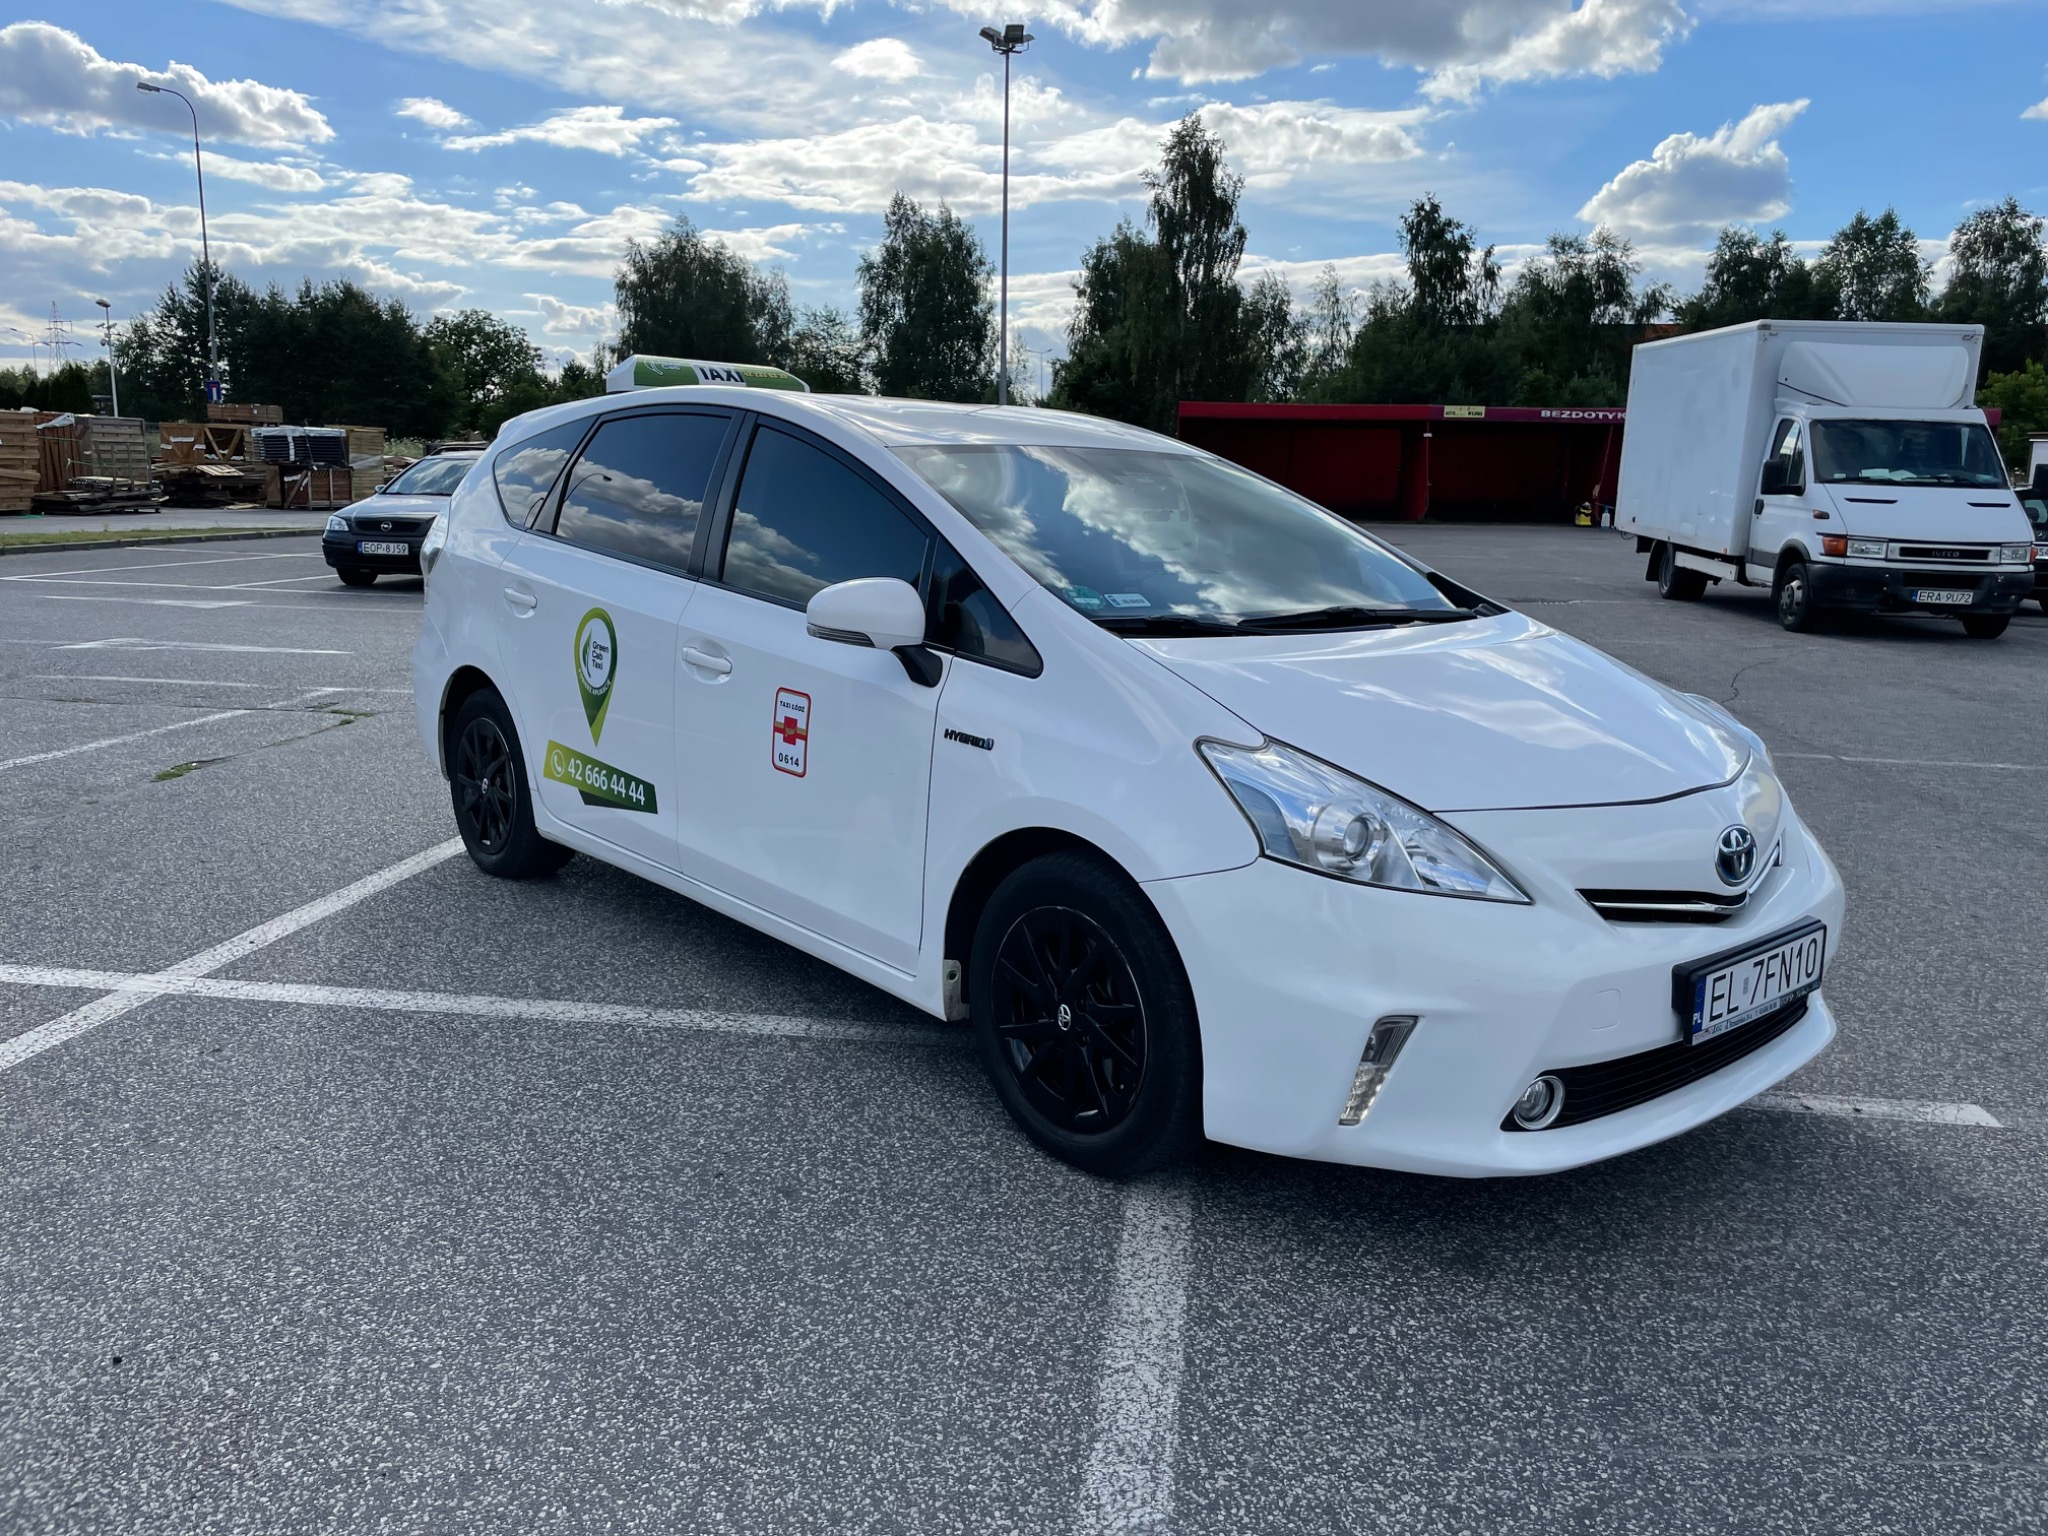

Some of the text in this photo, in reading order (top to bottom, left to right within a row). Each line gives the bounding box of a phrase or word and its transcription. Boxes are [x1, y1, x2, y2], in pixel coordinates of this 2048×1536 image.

[699, 365, 745, 383] TAXI
[363, 542, 407, 554] EOP 8J59
[1931, 550, 1960, 558] IVECO
[1918, 591, 1972, 604] ERA 9U72
[592, 640, 610, 654] Green
[591, 649, 603, 661] Cab
[591, 658, 604, 671] Taxi
[779, 700, 791, 710] TAXI
[943, 727, 987, 750] HYBRID
[778, 752, 800, 767] 0614
[567, 757, 645, 806] 42 666 44 44
[1709, 970, 1739, 1023] EL
[1750, 937, 1818, 1006] 7FN10
[1692, 1011, 1702, 1026] PL
